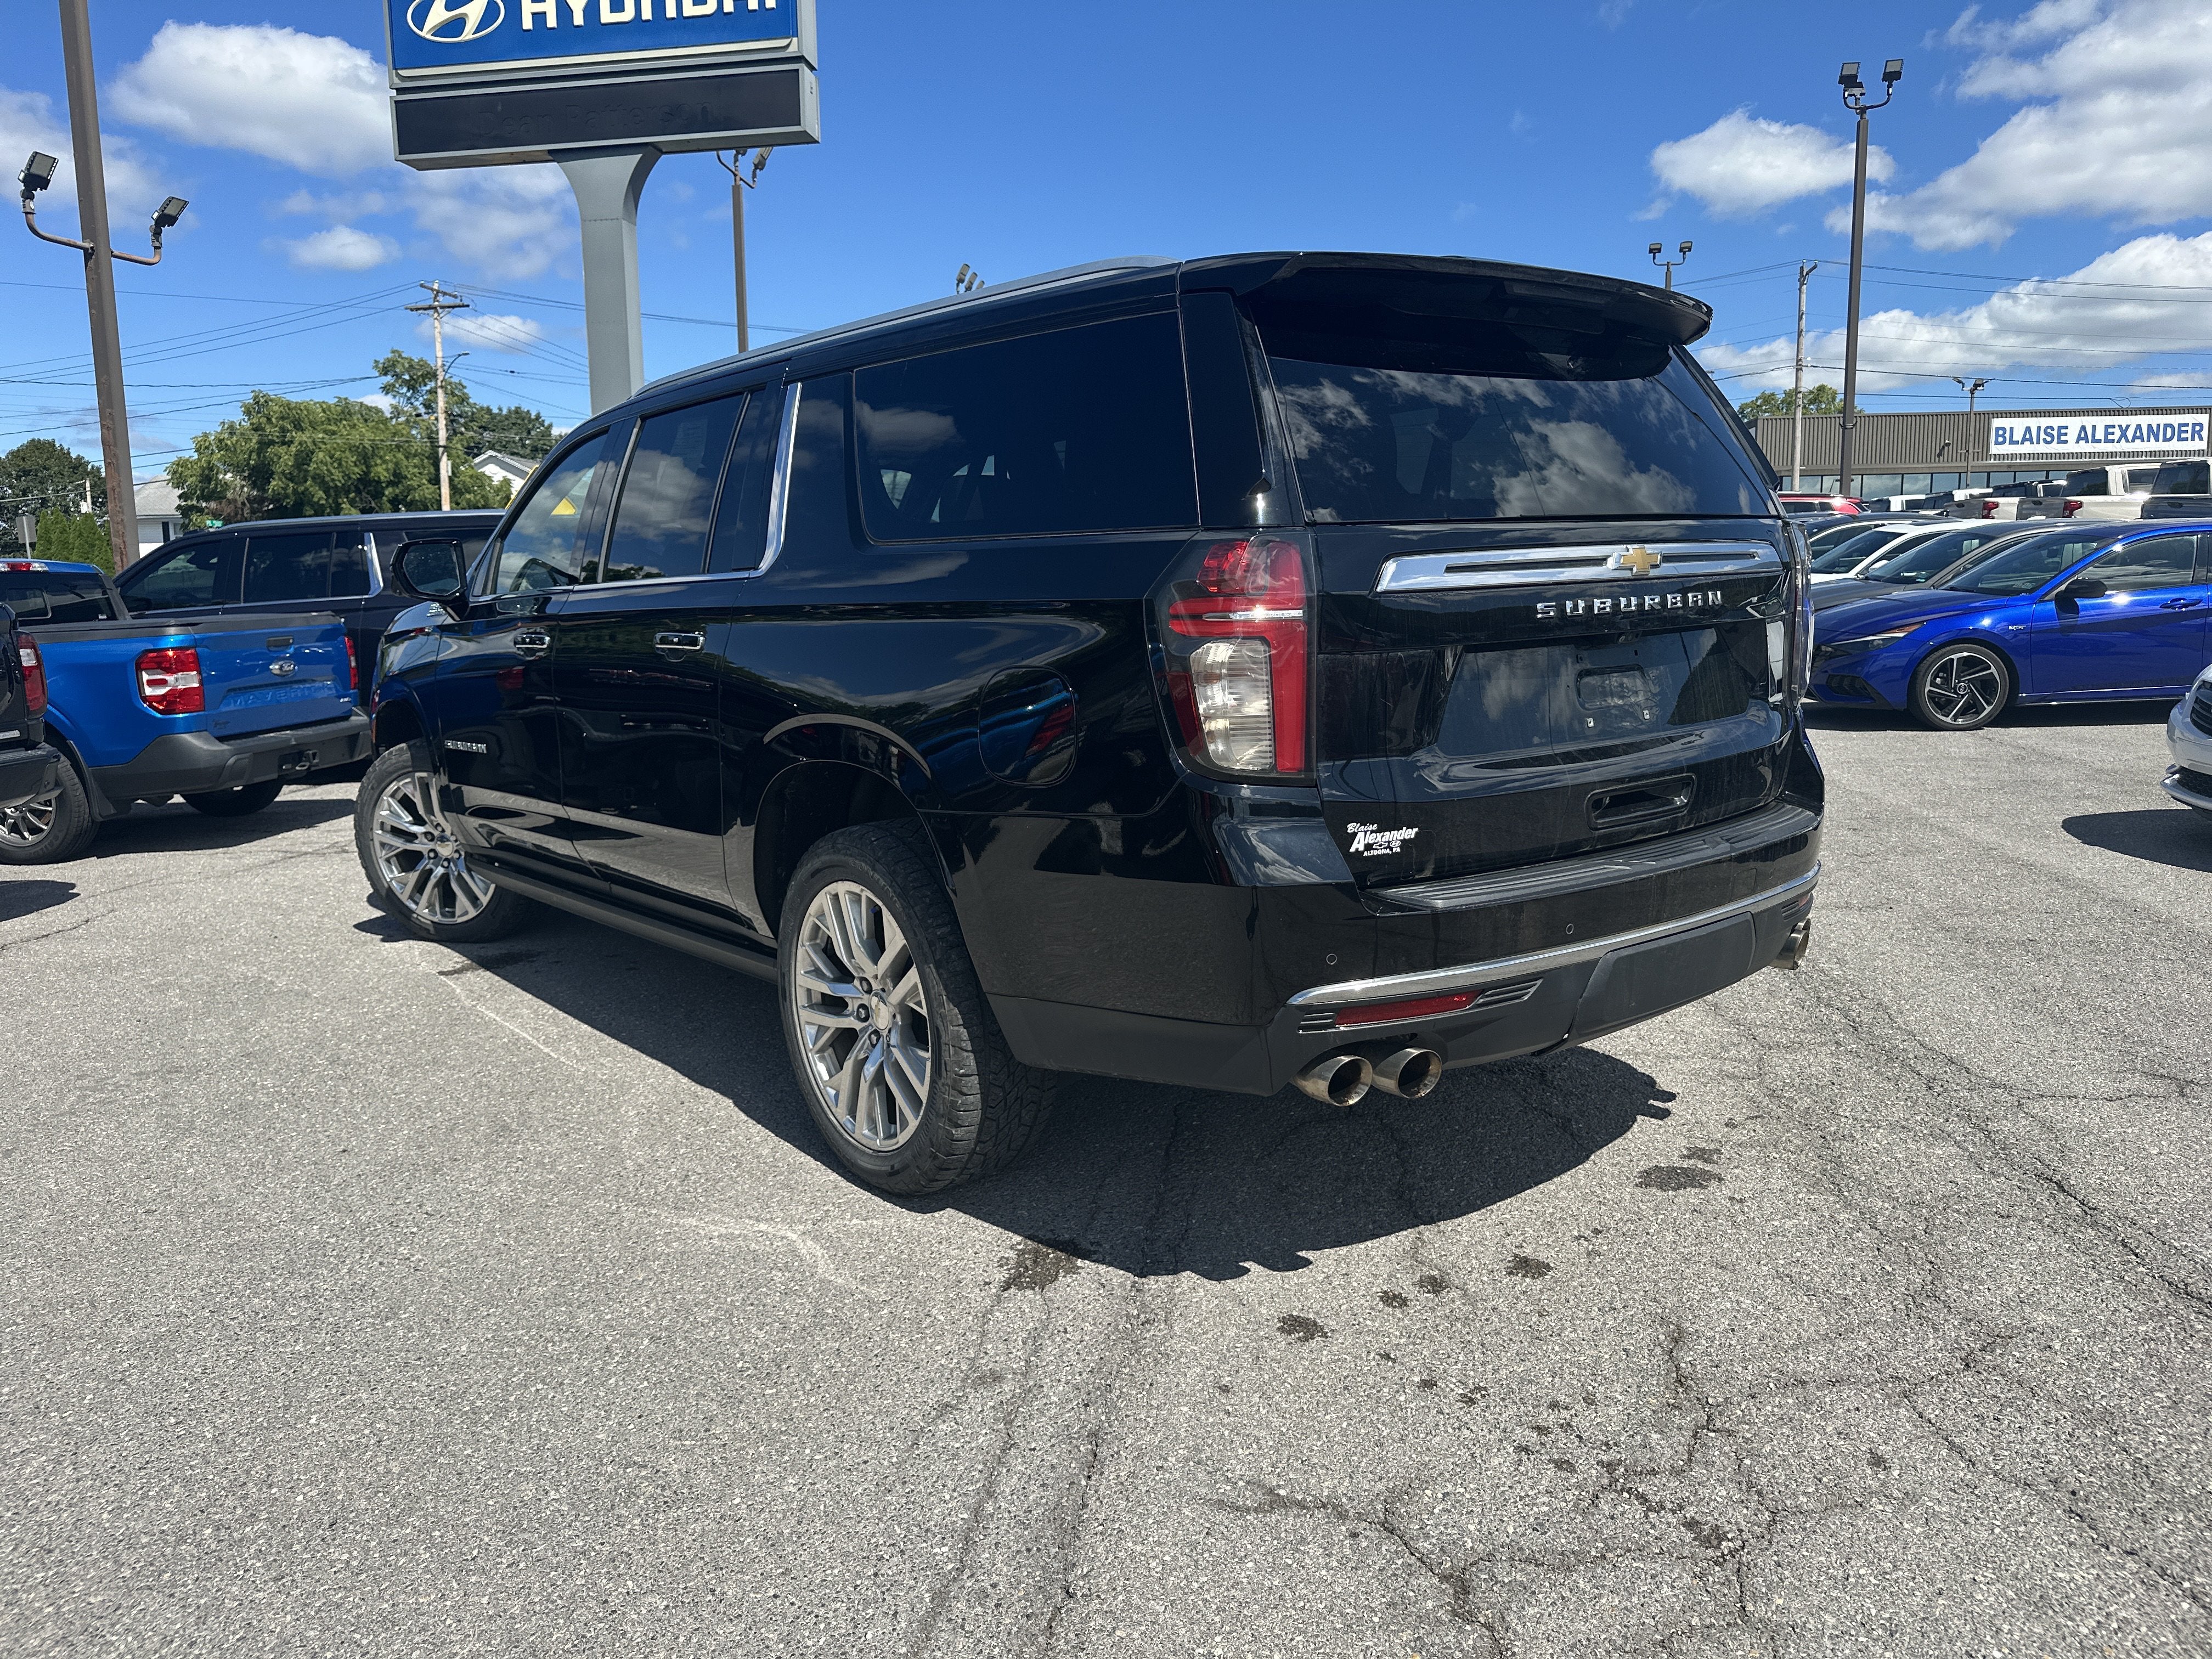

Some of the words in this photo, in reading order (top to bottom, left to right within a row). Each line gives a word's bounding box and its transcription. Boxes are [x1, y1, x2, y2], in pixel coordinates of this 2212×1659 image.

[521, 0, 776, 31] HYUN
[478, 111, 554, 135] Dean
[566, 101, 716, 131] Patterson
[1994, 425, 2069, 445] BLAISE
[2075, 422, 2204, 444] ALEXANDER
[1537, 590, 1722, 618] SUBURBAN
[1347, 822, 1378, 833] Blaise
[1349, 827, 1418, 852] Alexander
[1363, 848, 1392, 856] ALTOONA,
